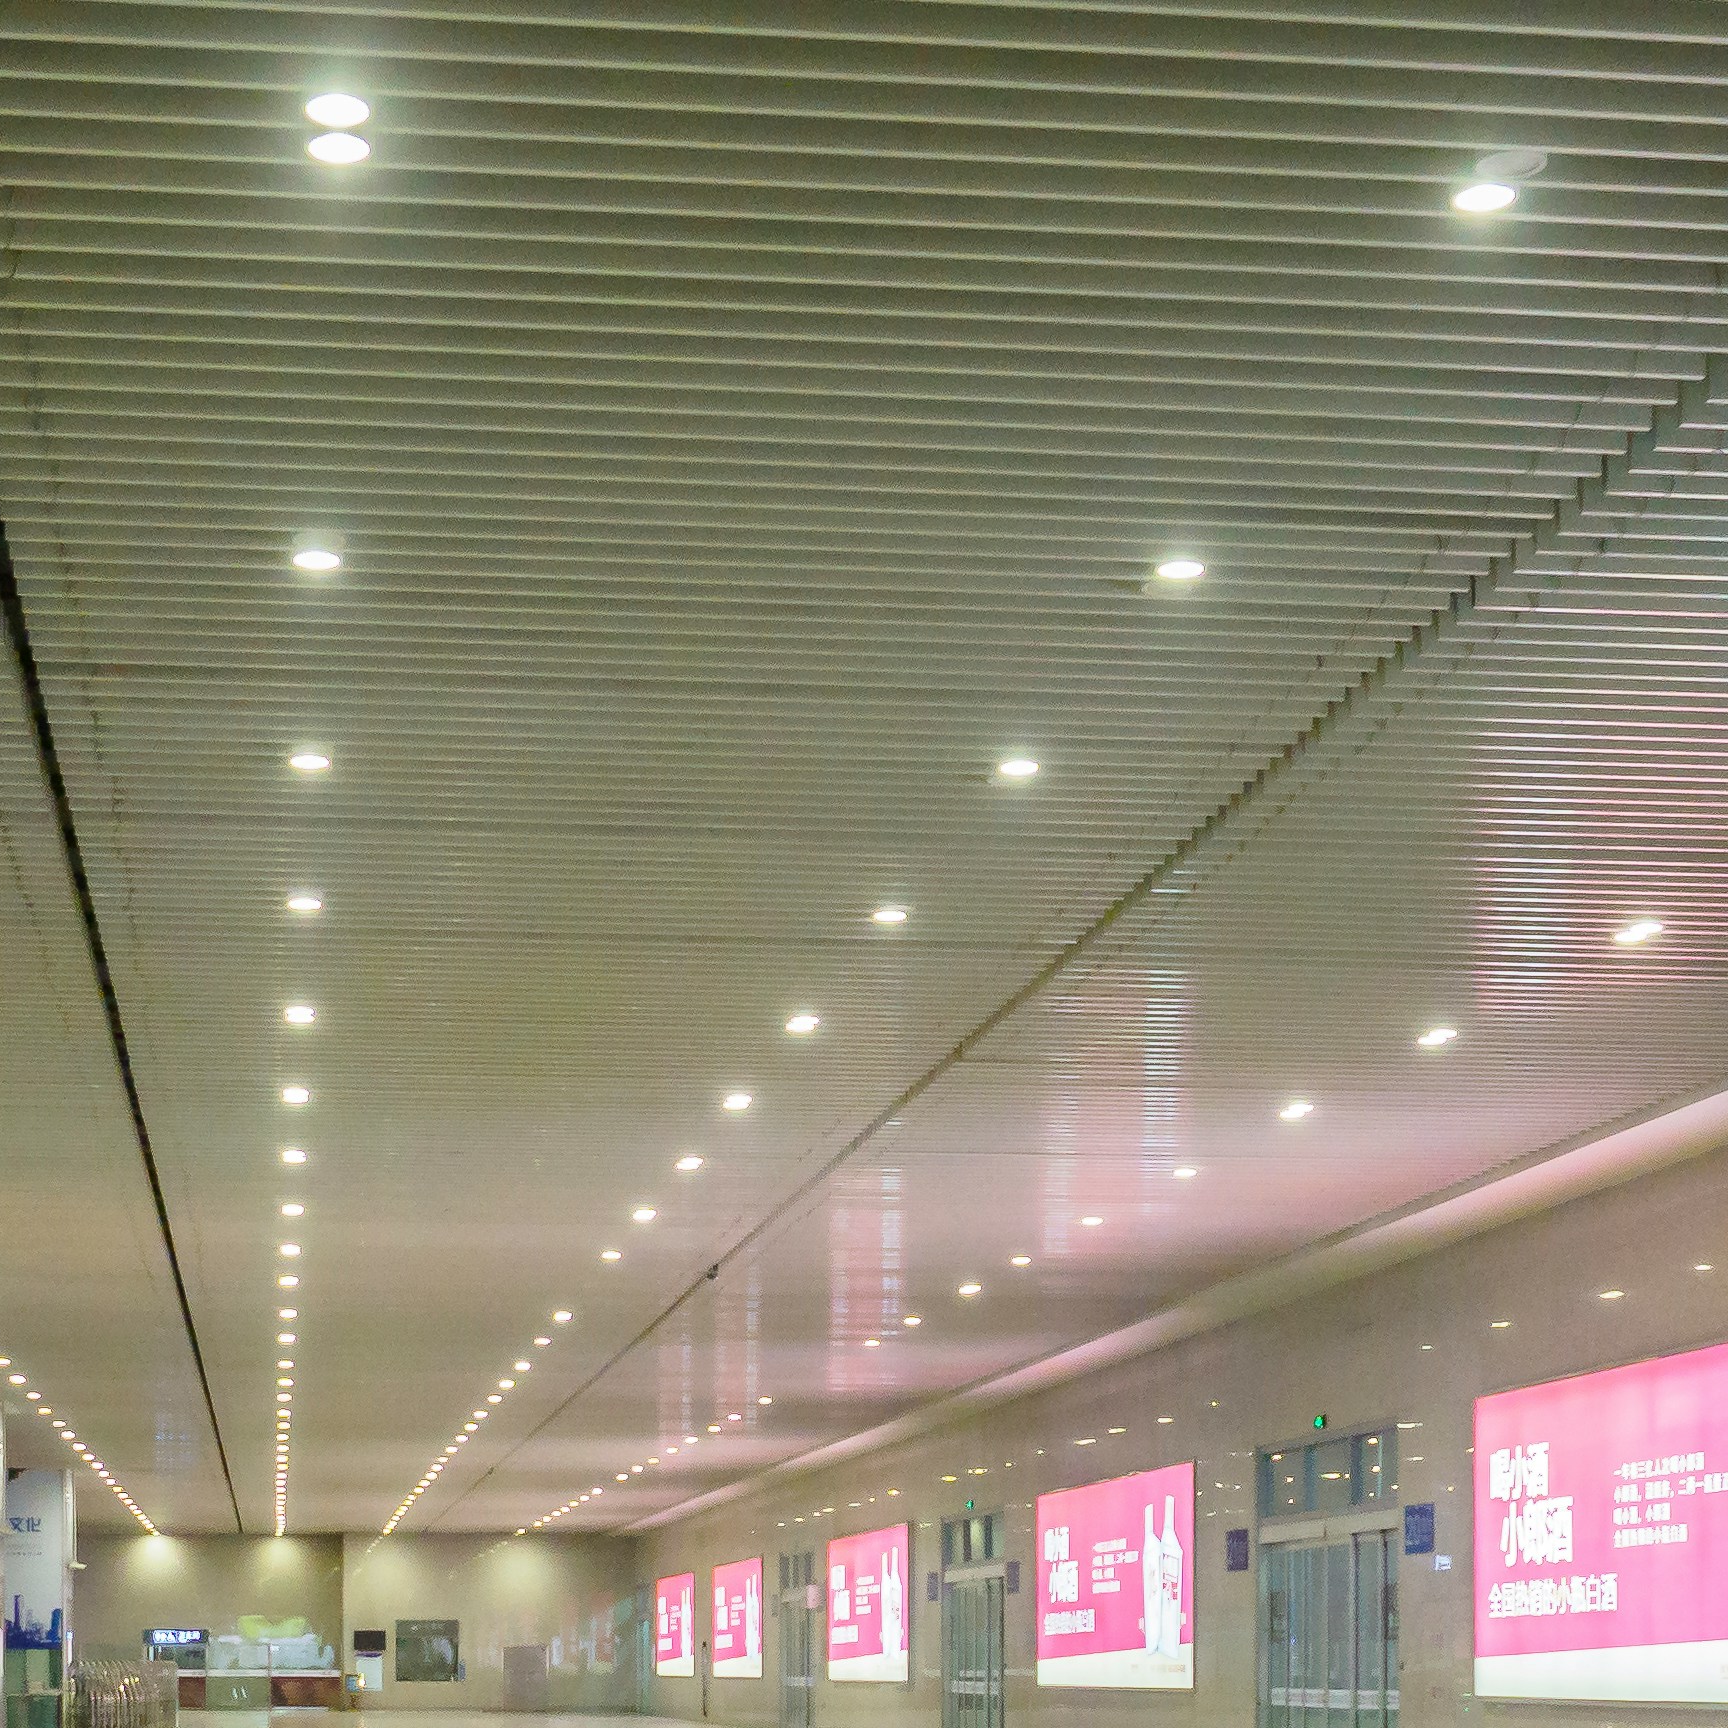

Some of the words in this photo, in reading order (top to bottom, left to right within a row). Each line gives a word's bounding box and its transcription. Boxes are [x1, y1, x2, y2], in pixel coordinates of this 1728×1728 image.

[1499, 1496, 1574, 1568] 小郎酒
[1488, 1572, 1618, 1618] 全国热销的小瓶白酒
